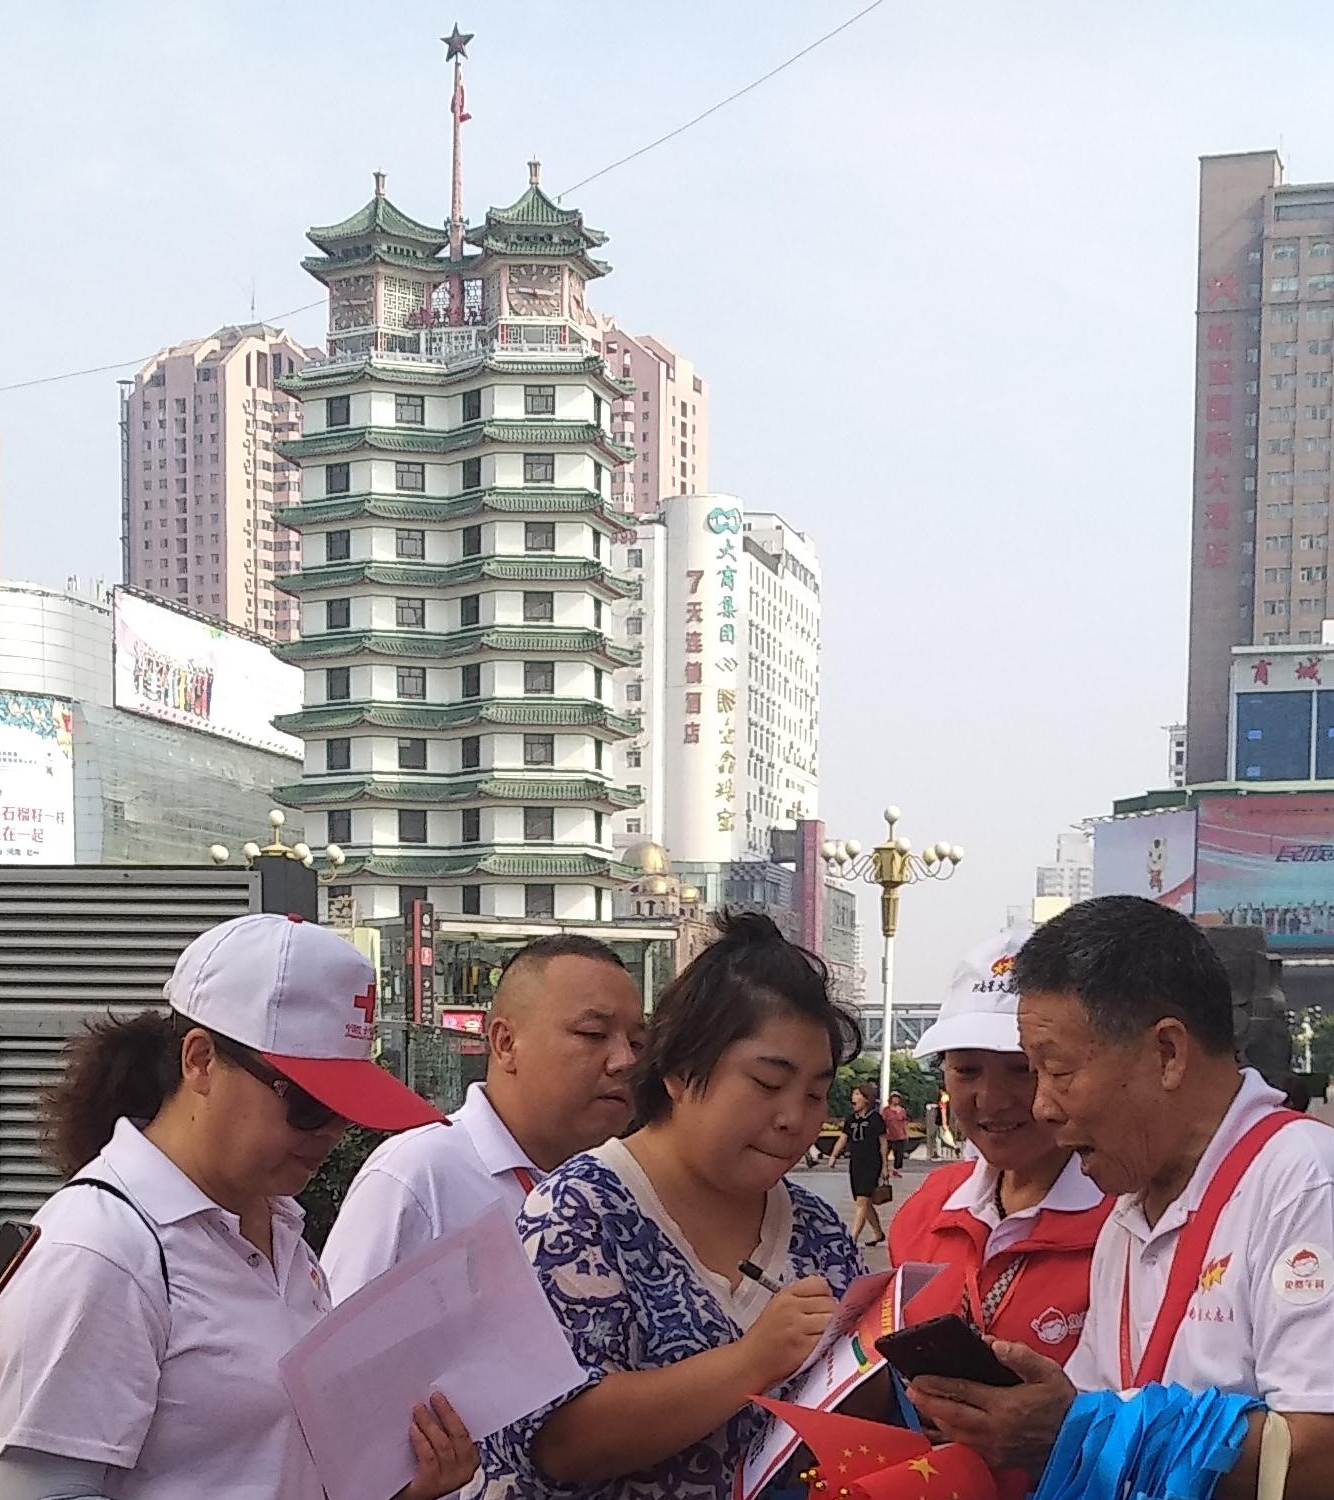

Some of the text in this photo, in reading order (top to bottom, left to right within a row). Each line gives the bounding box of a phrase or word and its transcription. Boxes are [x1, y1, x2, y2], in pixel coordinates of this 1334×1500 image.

[683, 569, 705, 744] 7天连锁酒店
